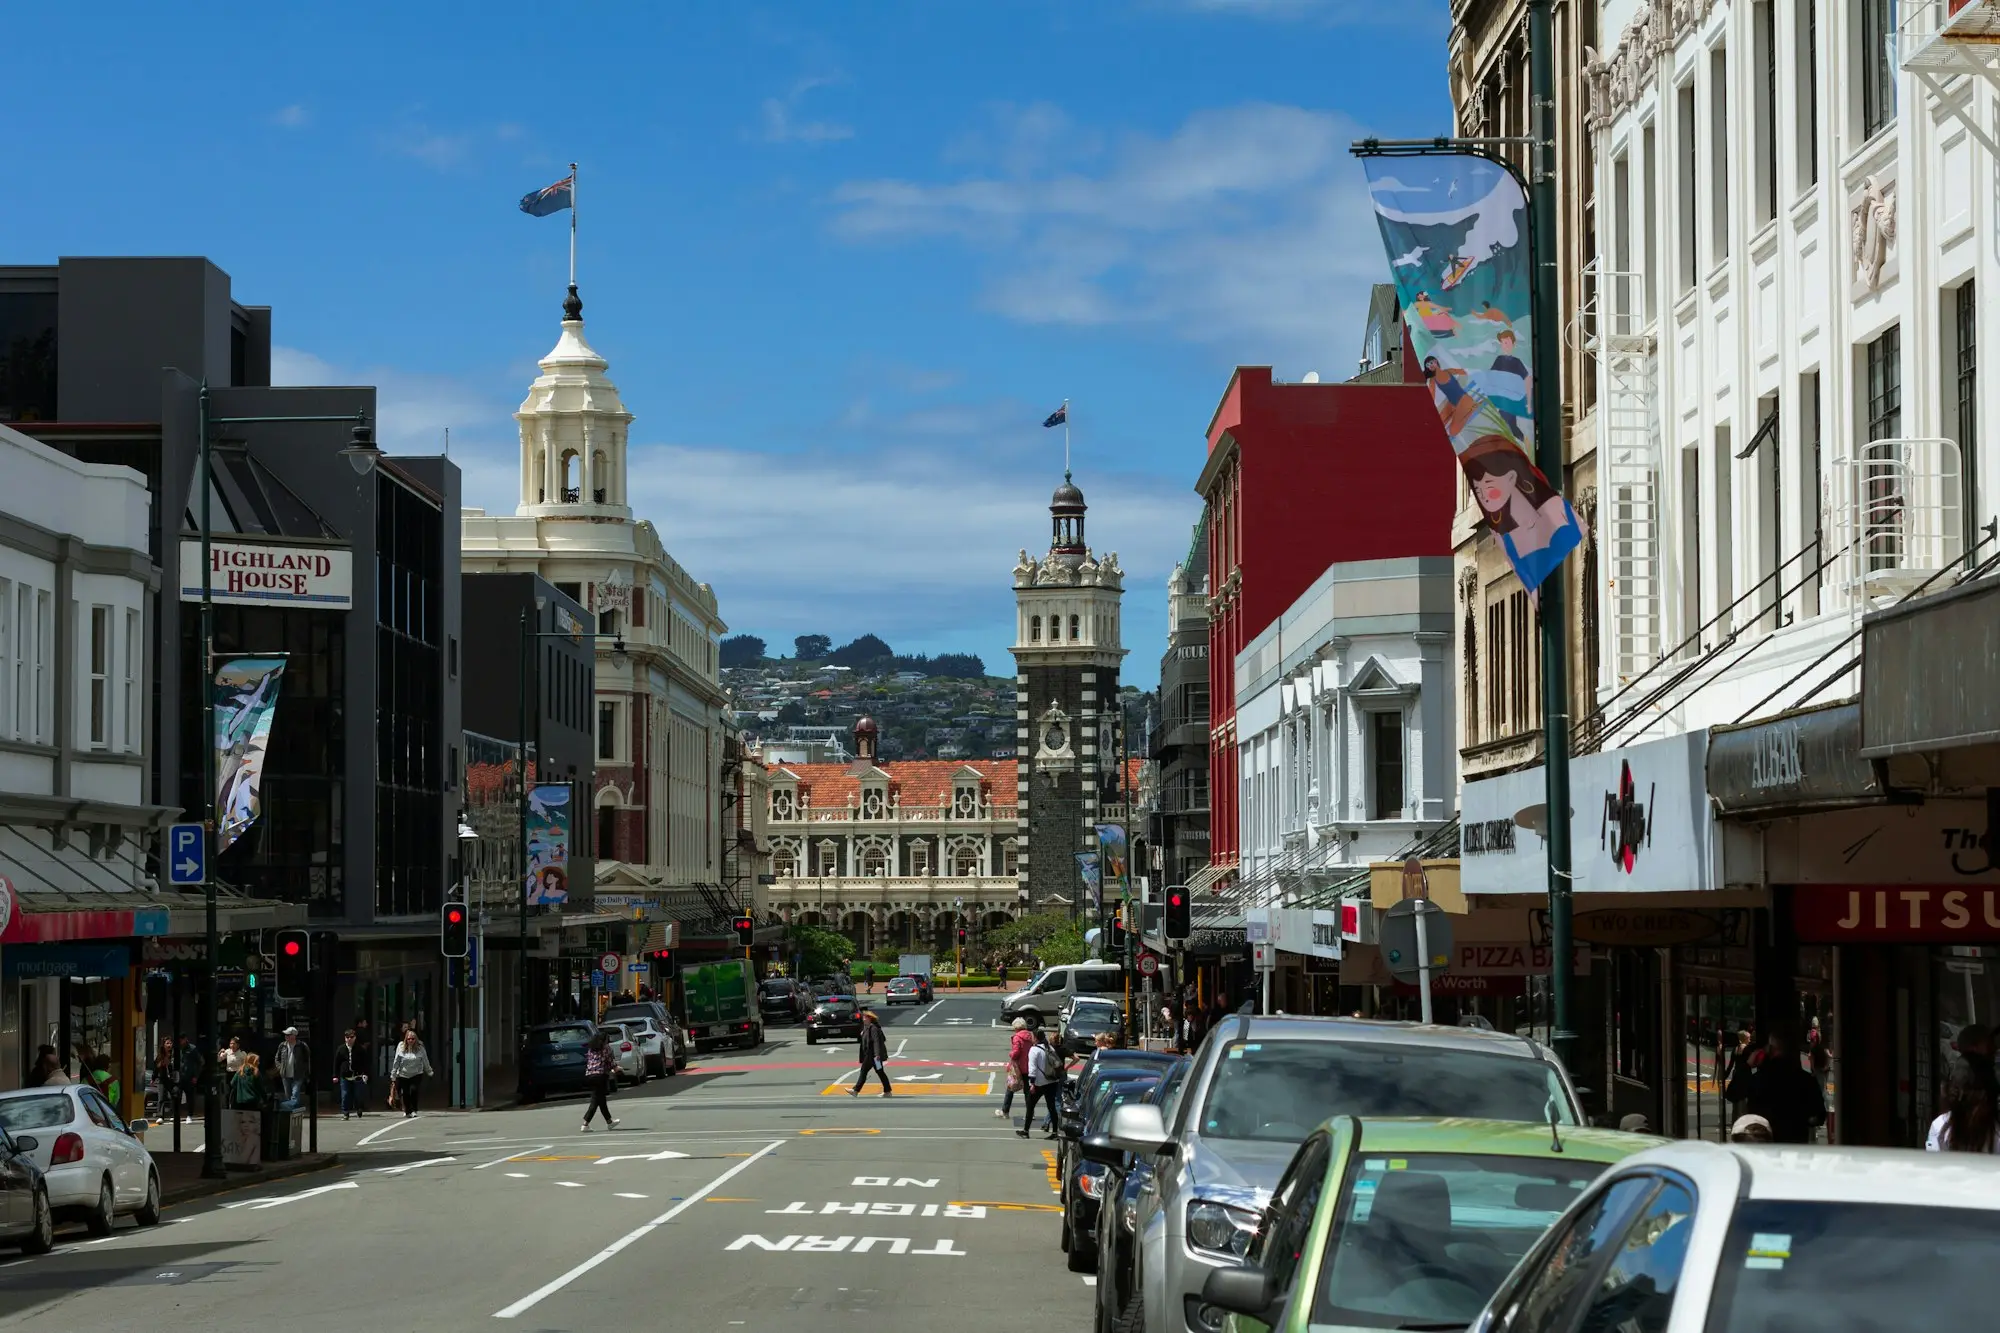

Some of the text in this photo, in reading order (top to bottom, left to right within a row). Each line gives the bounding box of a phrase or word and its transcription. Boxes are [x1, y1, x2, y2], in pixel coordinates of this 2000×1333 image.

[209, 548, 331, 578] HIGHLAND
[228, 570, 308, 595] HOUSE
[178, 831, 195, 851] P
[607, 896, 623, 905] Daily
[1836, 890, 2000, 929] JITSU
[1589, 913, 1690, 930] TWO CHEFS
[604, 958, 617, 968] 50
[1143, 960, 1155, 969] 50
[1461, 946, 1580, 967] PIZZA BR
[17, 959, 77, 975] mortgage
[1442, 975, 1488, 990] Worth
[850, 1176, 941, 1188] NO
[765, 1201, 987, 1219] RIGHT
[724, 1234, 967, 1256] TURN
